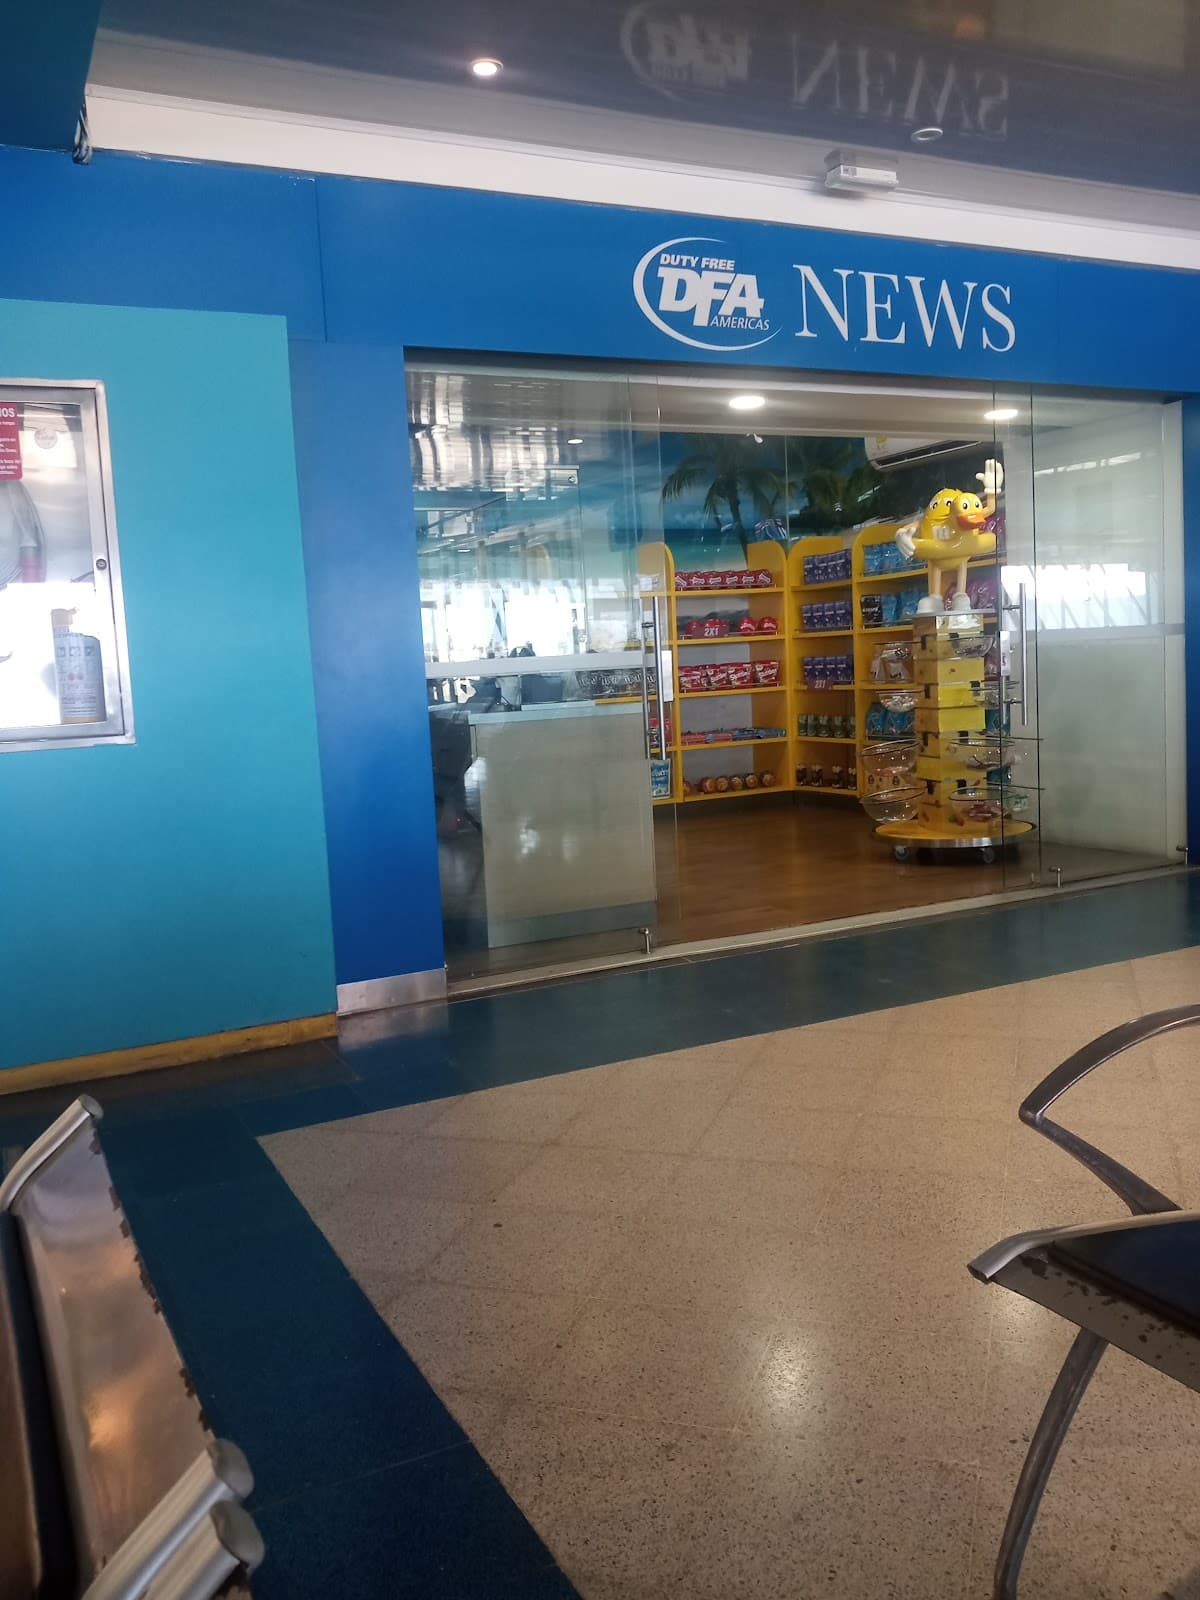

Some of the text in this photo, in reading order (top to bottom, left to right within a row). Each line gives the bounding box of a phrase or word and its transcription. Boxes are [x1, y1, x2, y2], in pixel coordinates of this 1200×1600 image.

[660, 253, 735, 271] DUTY FREE
[657, 266, 765, 327] DFA
[793, 264, 1016, 353] NEWS
[710, 315, 770, 331] AMERICAS
[0, 407, 16, 418] OS
[703, 627, 720, 637] 2X1
